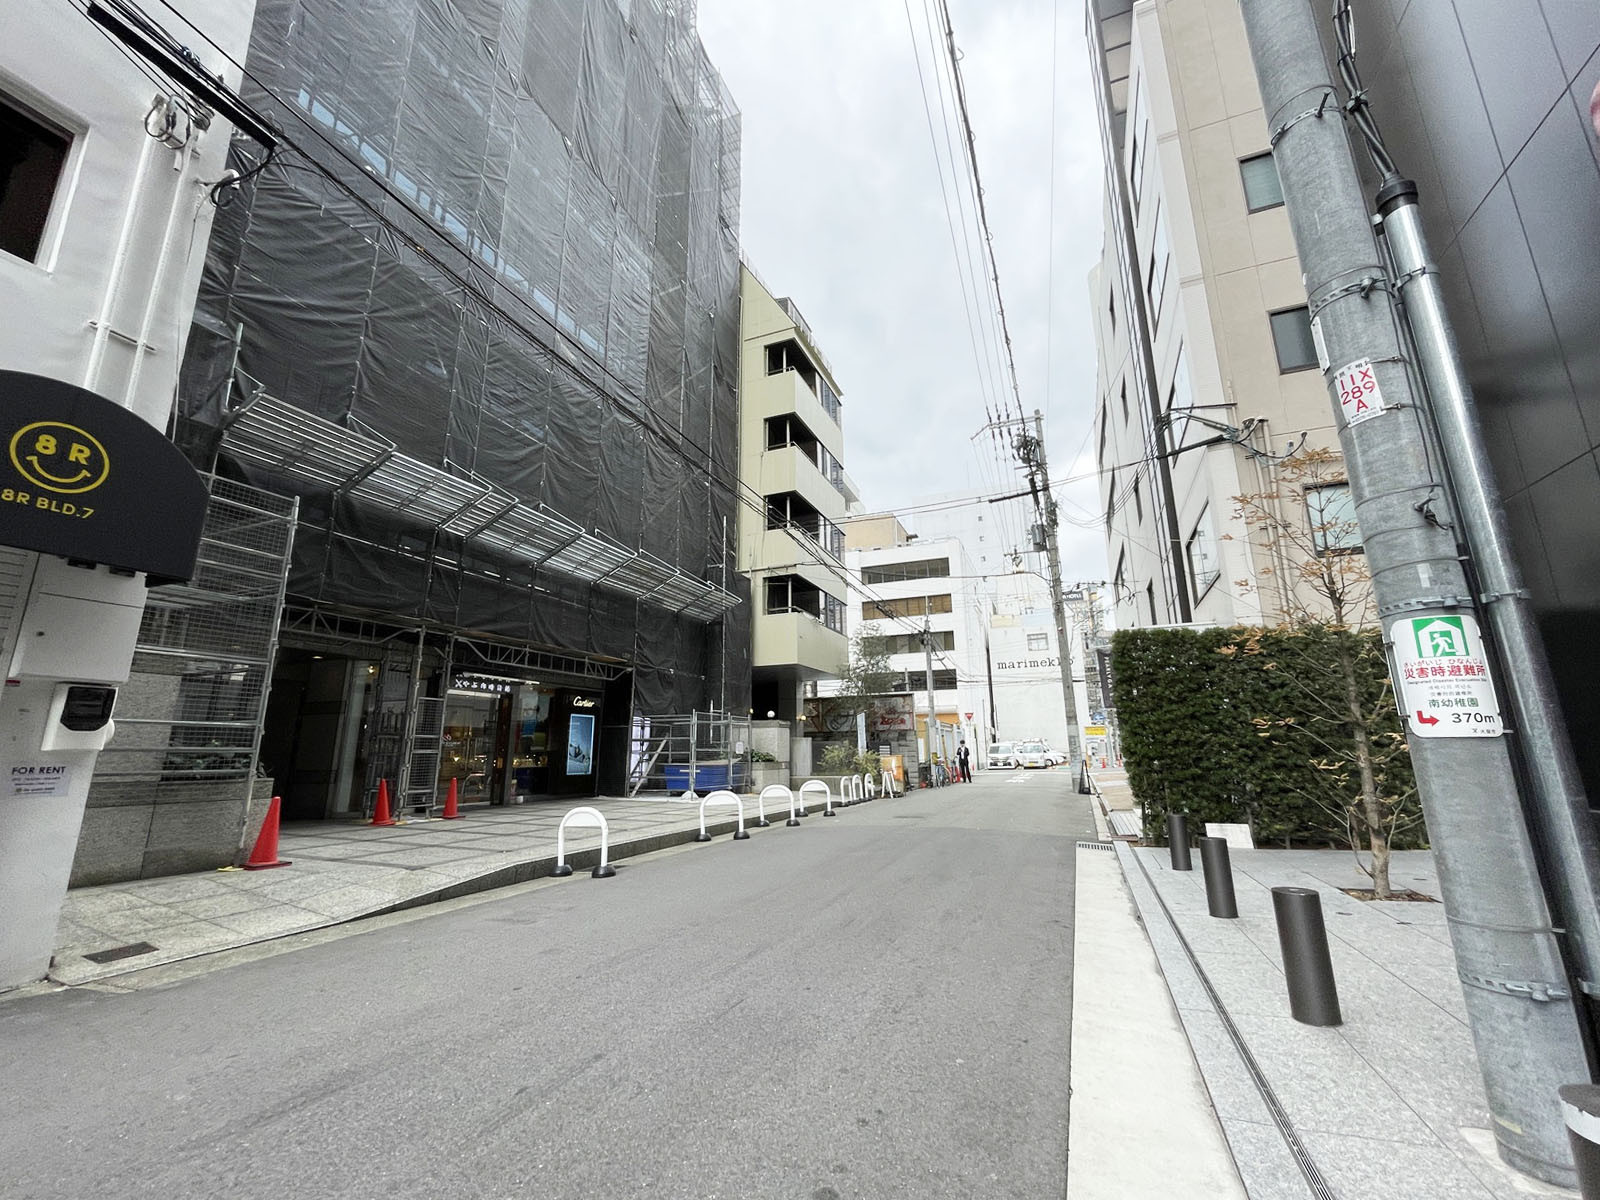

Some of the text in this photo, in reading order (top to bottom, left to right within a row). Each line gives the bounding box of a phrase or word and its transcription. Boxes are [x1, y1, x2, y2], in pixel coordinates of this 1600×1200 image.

[1341, 381, 1375, 406] 289
[1356, 399, 1368, 413] A
[36, 434, 91, 465] 8 R
[1, 489, 95, 519] 8R BLD.7
[1404, 664, 1486, 680] 災害時避難所
[573, 696, 595, 708] Cartier
[1429, 697, 1479, 708] 南幼稚園
[1451, 712, 1496, 724] 370m
[11, 766, 66, 775] FOR RENT
